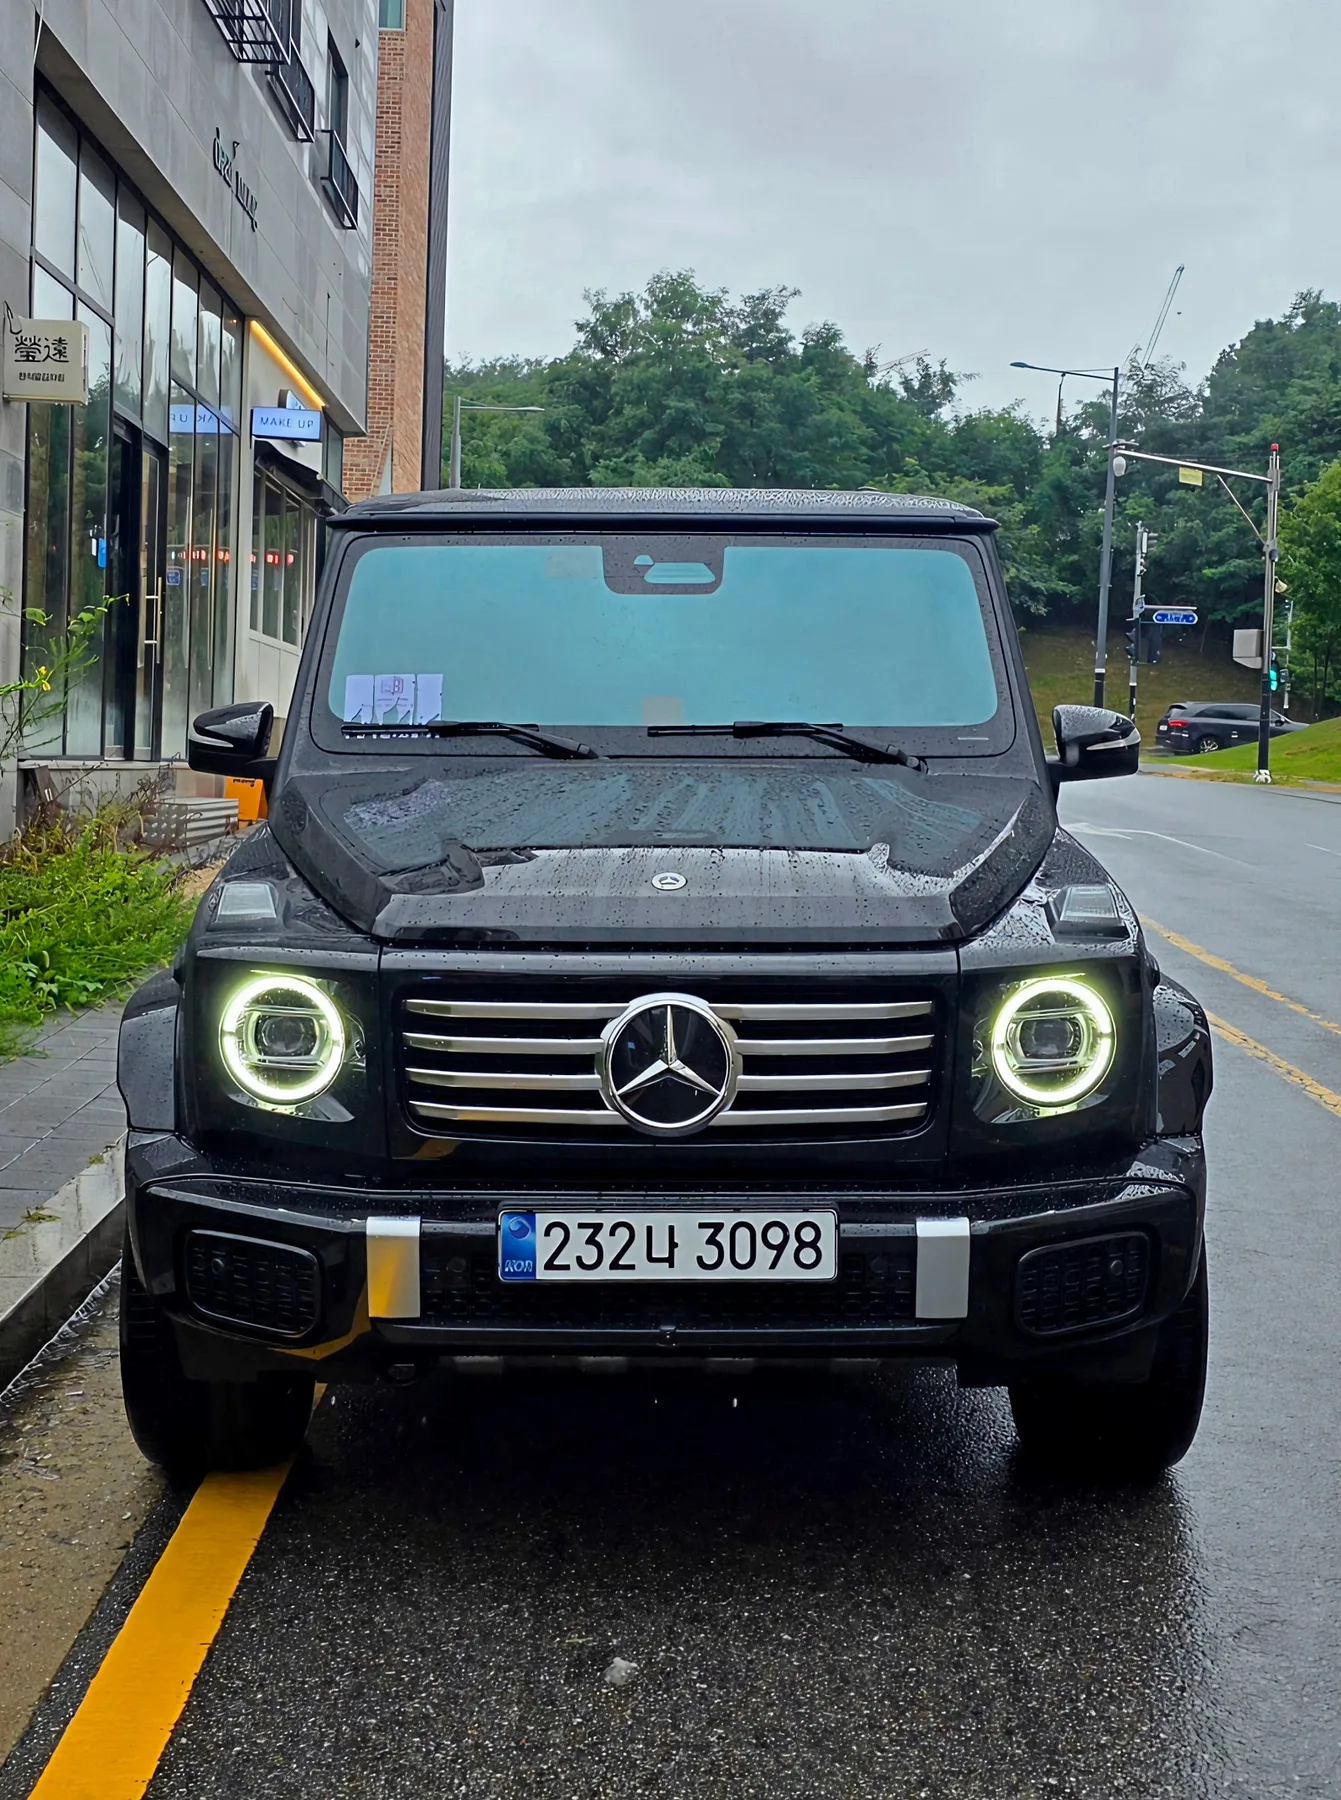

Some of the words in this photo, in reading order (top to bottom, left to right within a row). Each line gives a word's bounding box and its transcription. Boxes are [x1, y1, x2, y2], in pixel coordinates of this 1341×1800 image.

[260, 416, 292, 428] MAKE
[298, 419, 314, 429] UP
[542, 1220, 679, 1272] 232나
[696, 1220, 823, 1271] 3098
